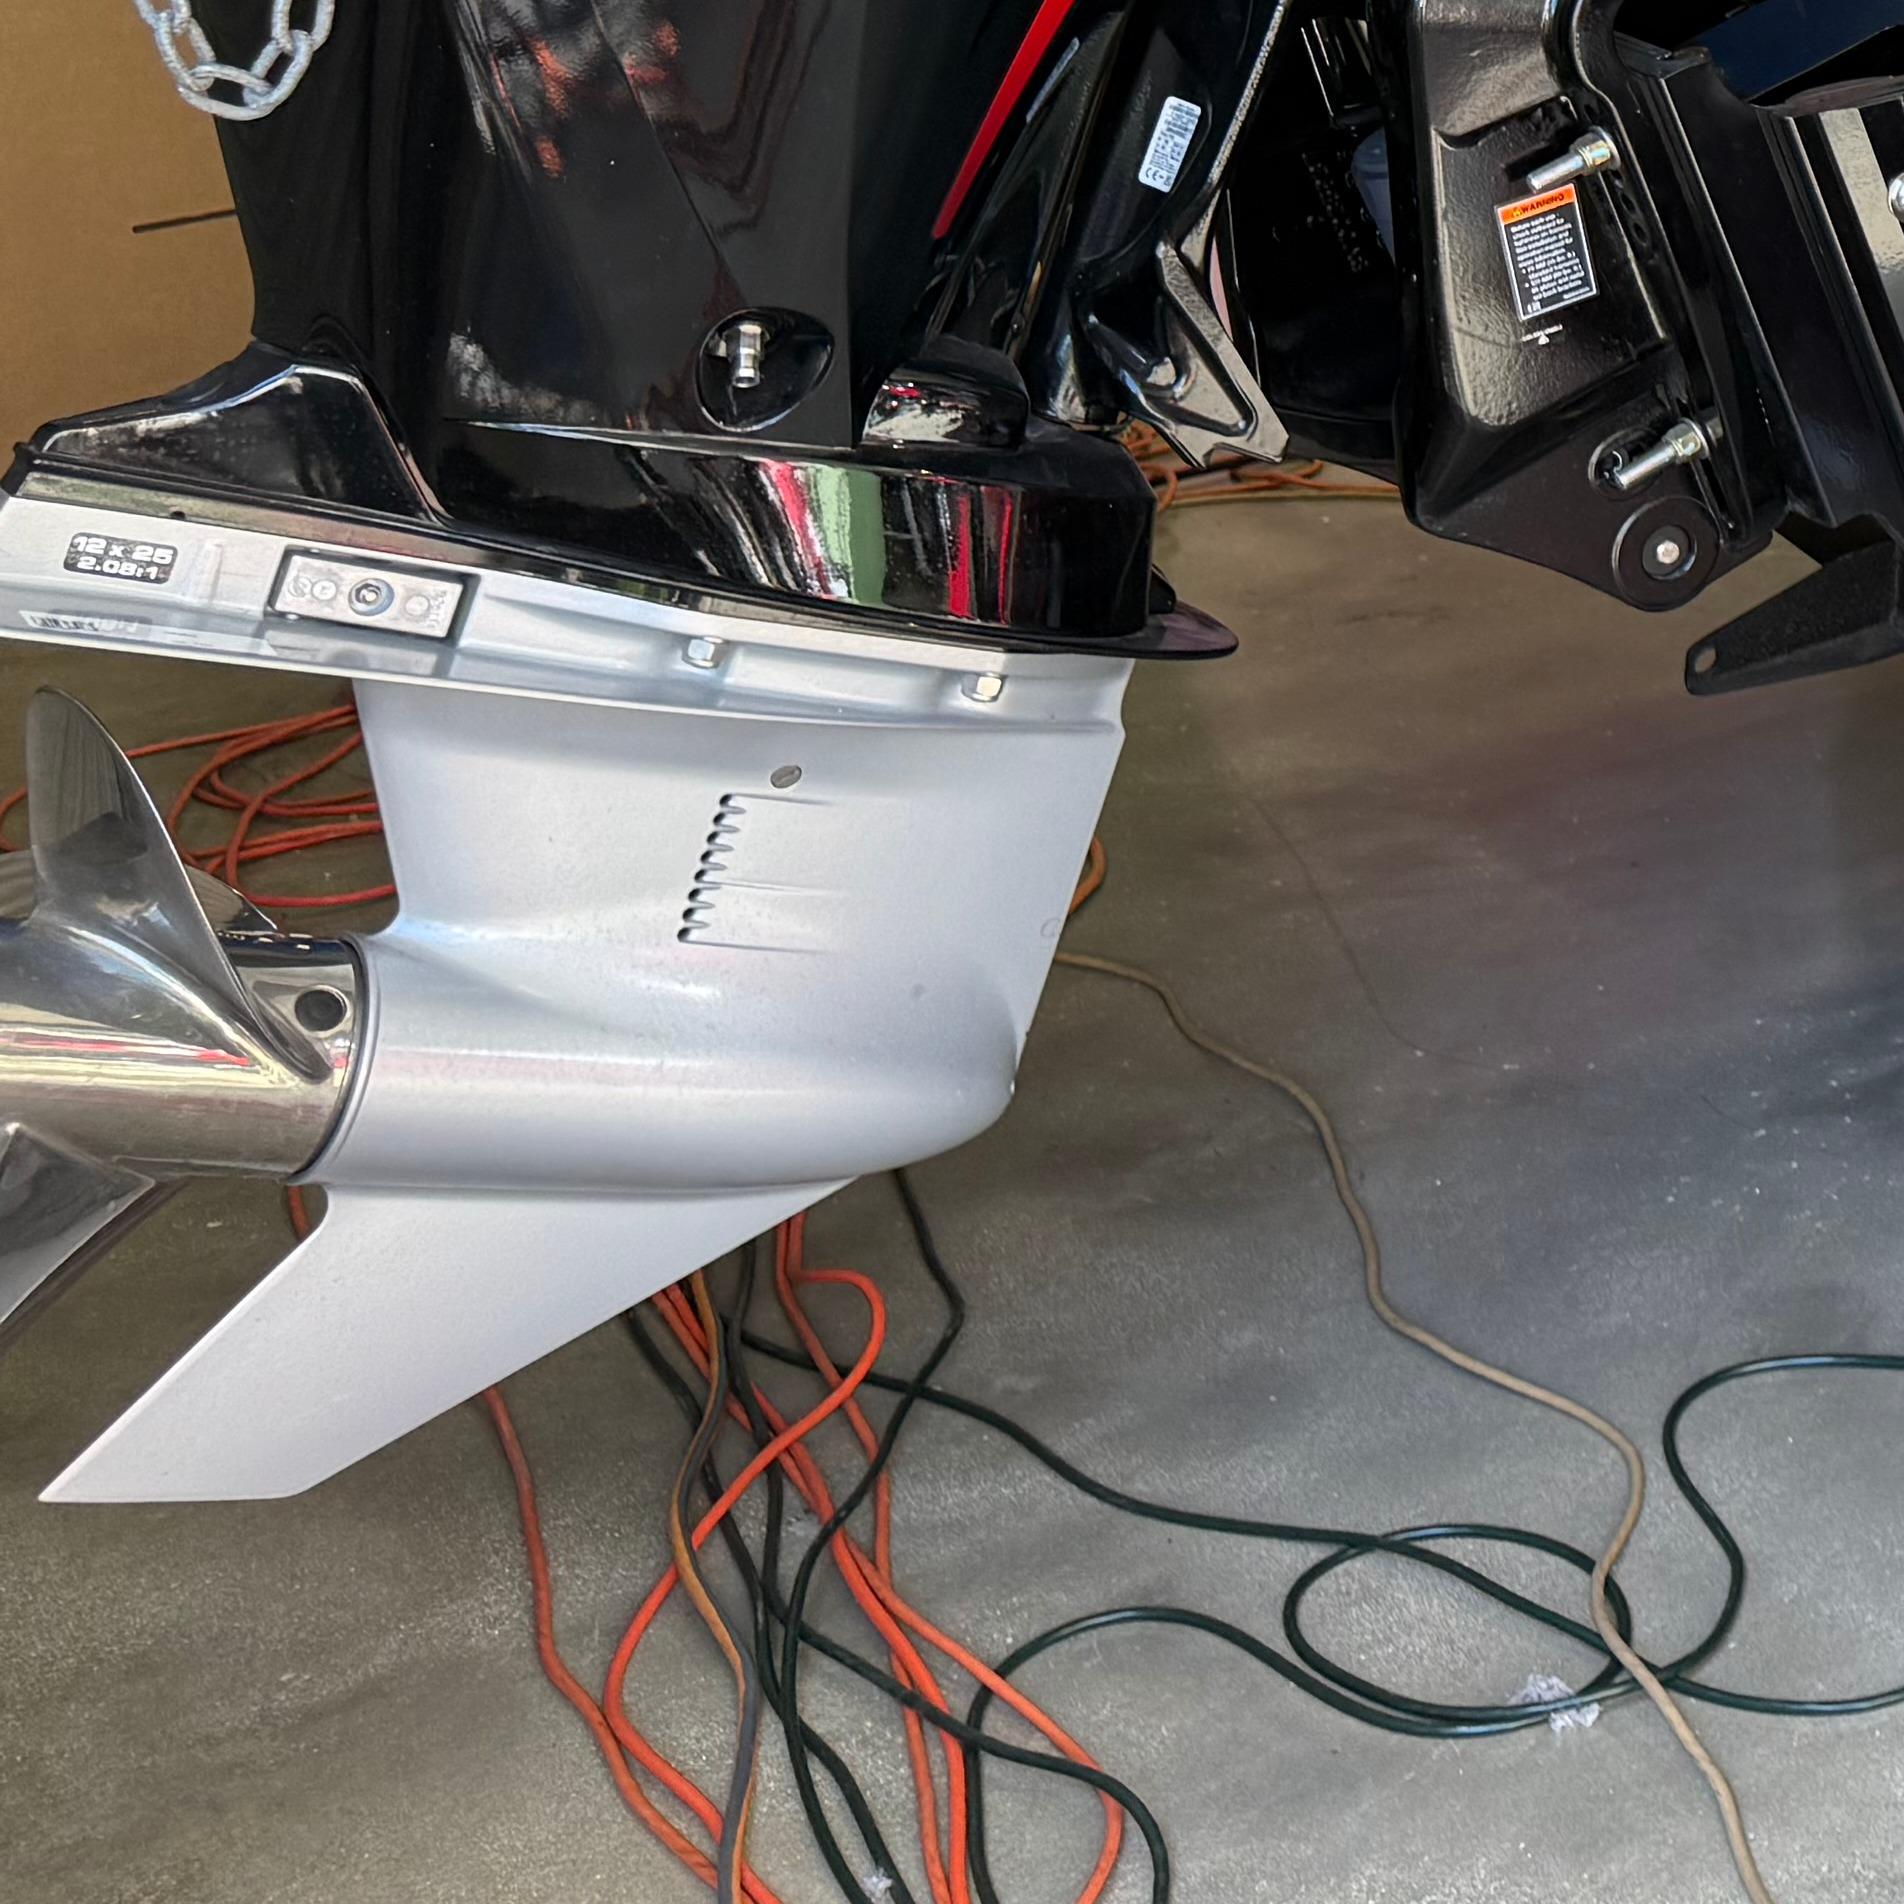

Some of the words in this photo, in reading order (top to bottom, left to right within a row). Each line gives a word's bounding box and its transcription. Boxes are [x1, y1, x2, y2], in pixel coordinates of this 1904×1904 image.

[1522, 192, 1566, 215] WARNING
[72, 535, 108, 556] 12
[131, 544, 175, 566] 25
[76, 555, 159, 581] 2.08:1
